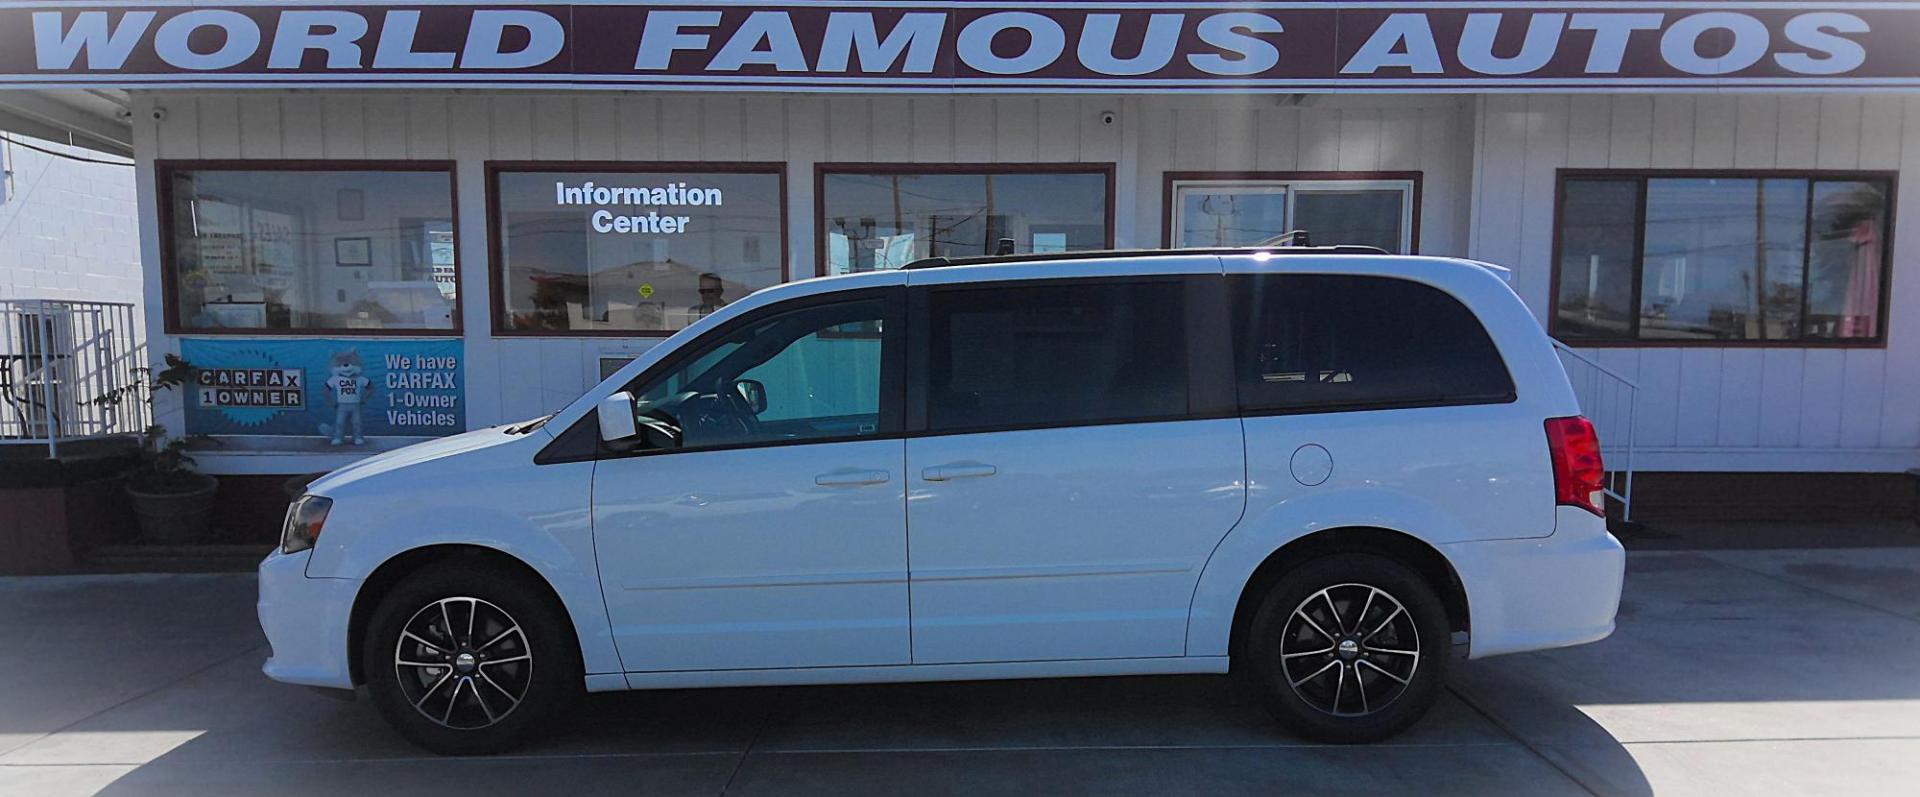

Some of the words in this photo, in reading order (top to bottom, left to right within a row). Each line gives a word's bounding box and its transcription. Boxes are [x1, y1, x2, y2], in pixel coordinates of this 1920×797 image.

[32, 9, 565, 70] WORLD
[634, 10, 1285, 75] FAMOUS
[1339, 11, 1870, 75] AUTOS
[556, 182, 722, 206] Information
[592, 209, 690, 234] Center
[385, 354, 410, 369] We
[416, 354, 456, 369] have
[200, 370, 299, 388] CARFAX
[339, 379, 357, 387] CAR
[386, 373, 456, 389] CARFAX
[203, 392, 214, 404] 1
[218, 392, 300, 405] OWNER
[340, 388, 356, 396] FOX
[388, 392, 456, 408] 1-Owner
[387, 411, 456, 426] Vehicles
